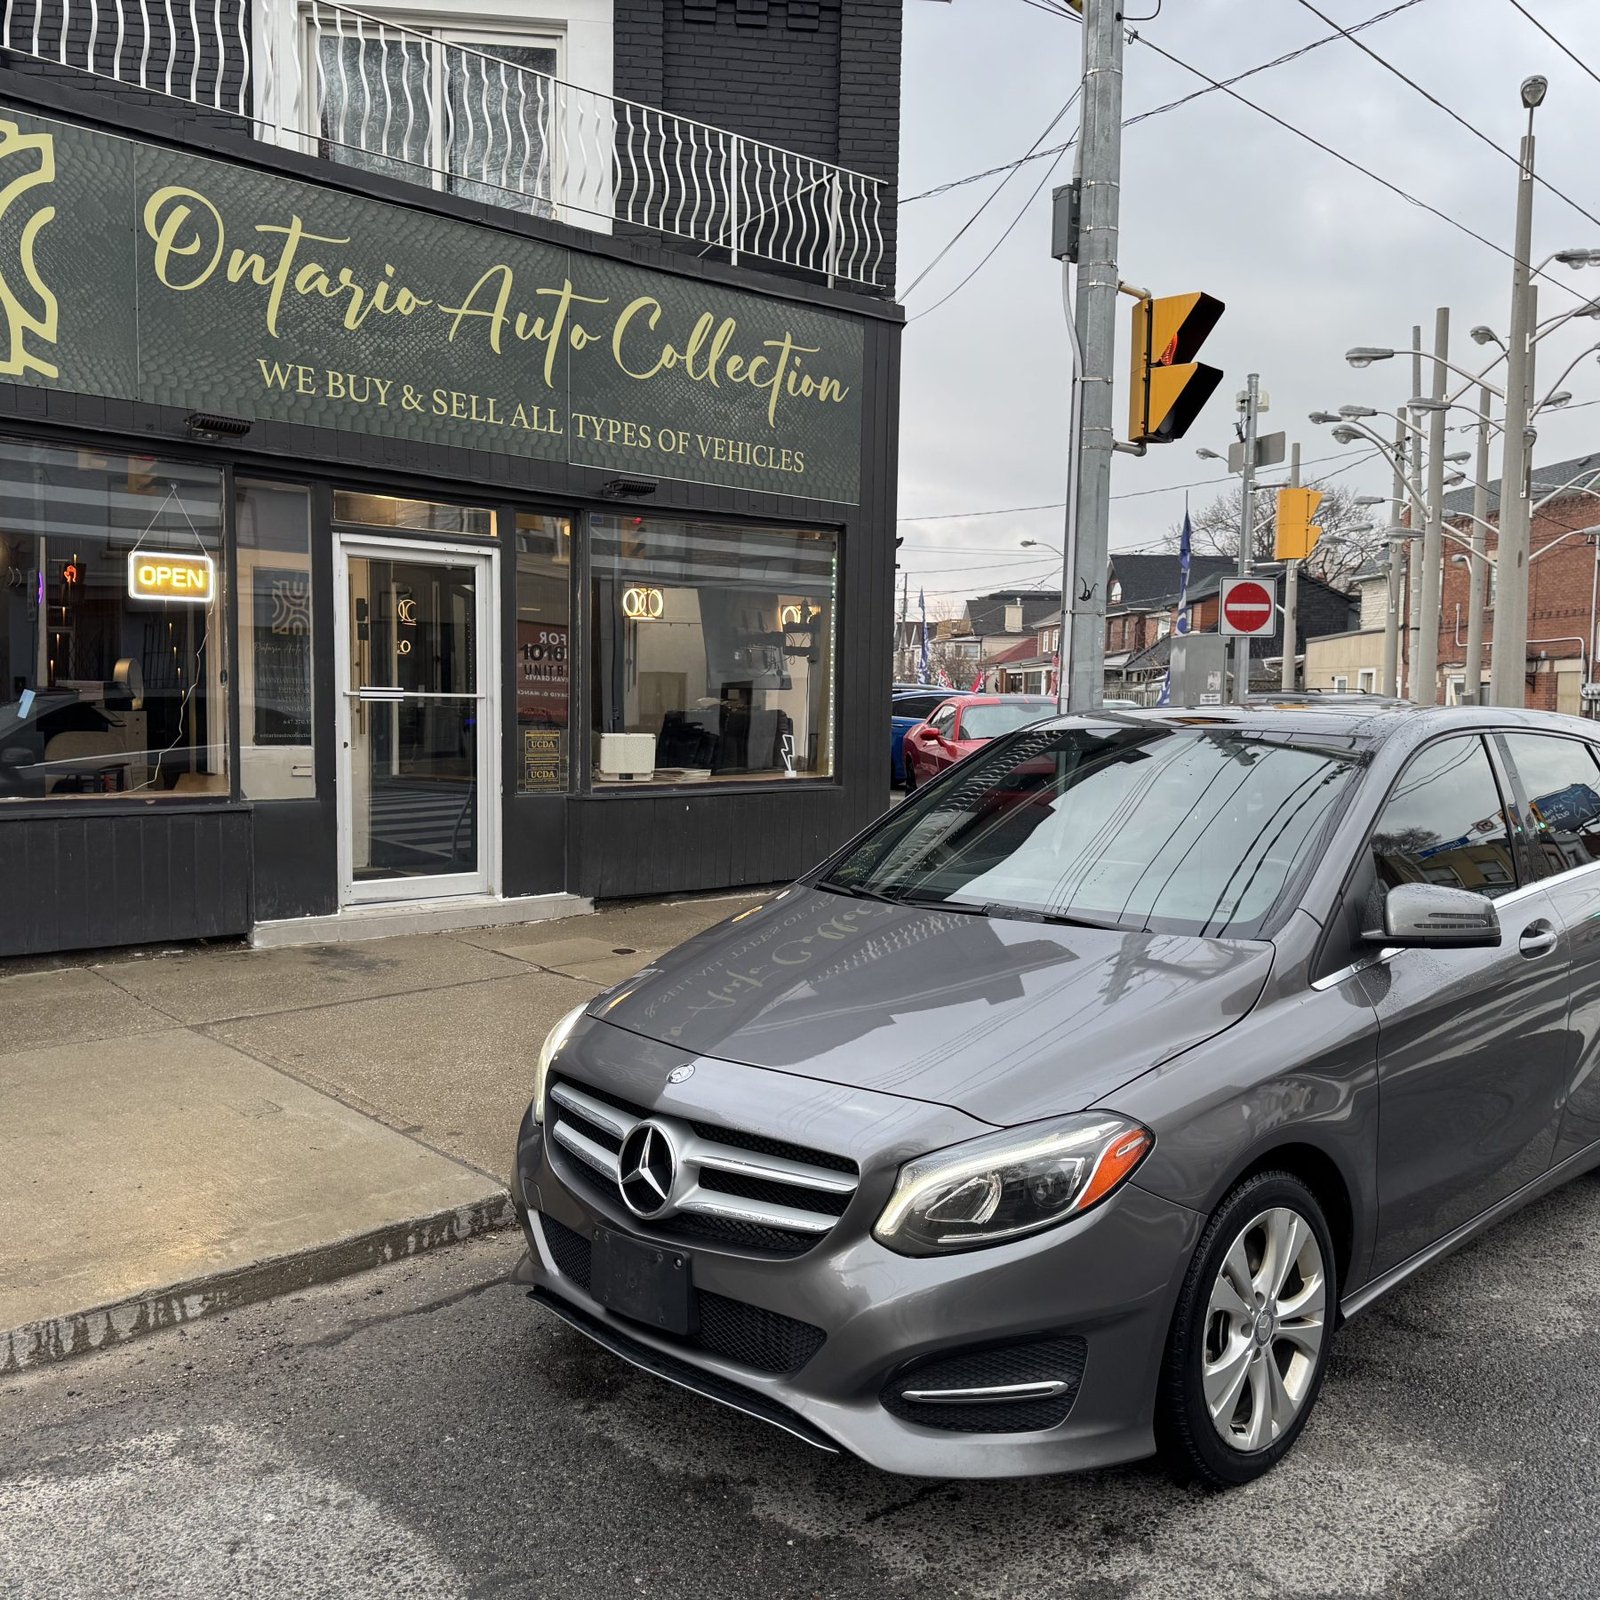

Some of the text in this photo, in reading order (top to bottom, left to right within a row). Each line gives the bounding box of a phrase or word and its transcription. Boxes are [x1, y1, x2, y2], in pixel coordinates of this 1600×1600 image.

[143, 186, 849, 428] Ontario Auto Collection
[257, 358, 805, 473] WE BUY & SELL ALL TYPES OF VEHICLES
[139, 565, 204, 588] OPEN
[524, 665, 554, 676] UNIT
[530, 770, 555, 778] UCDA
